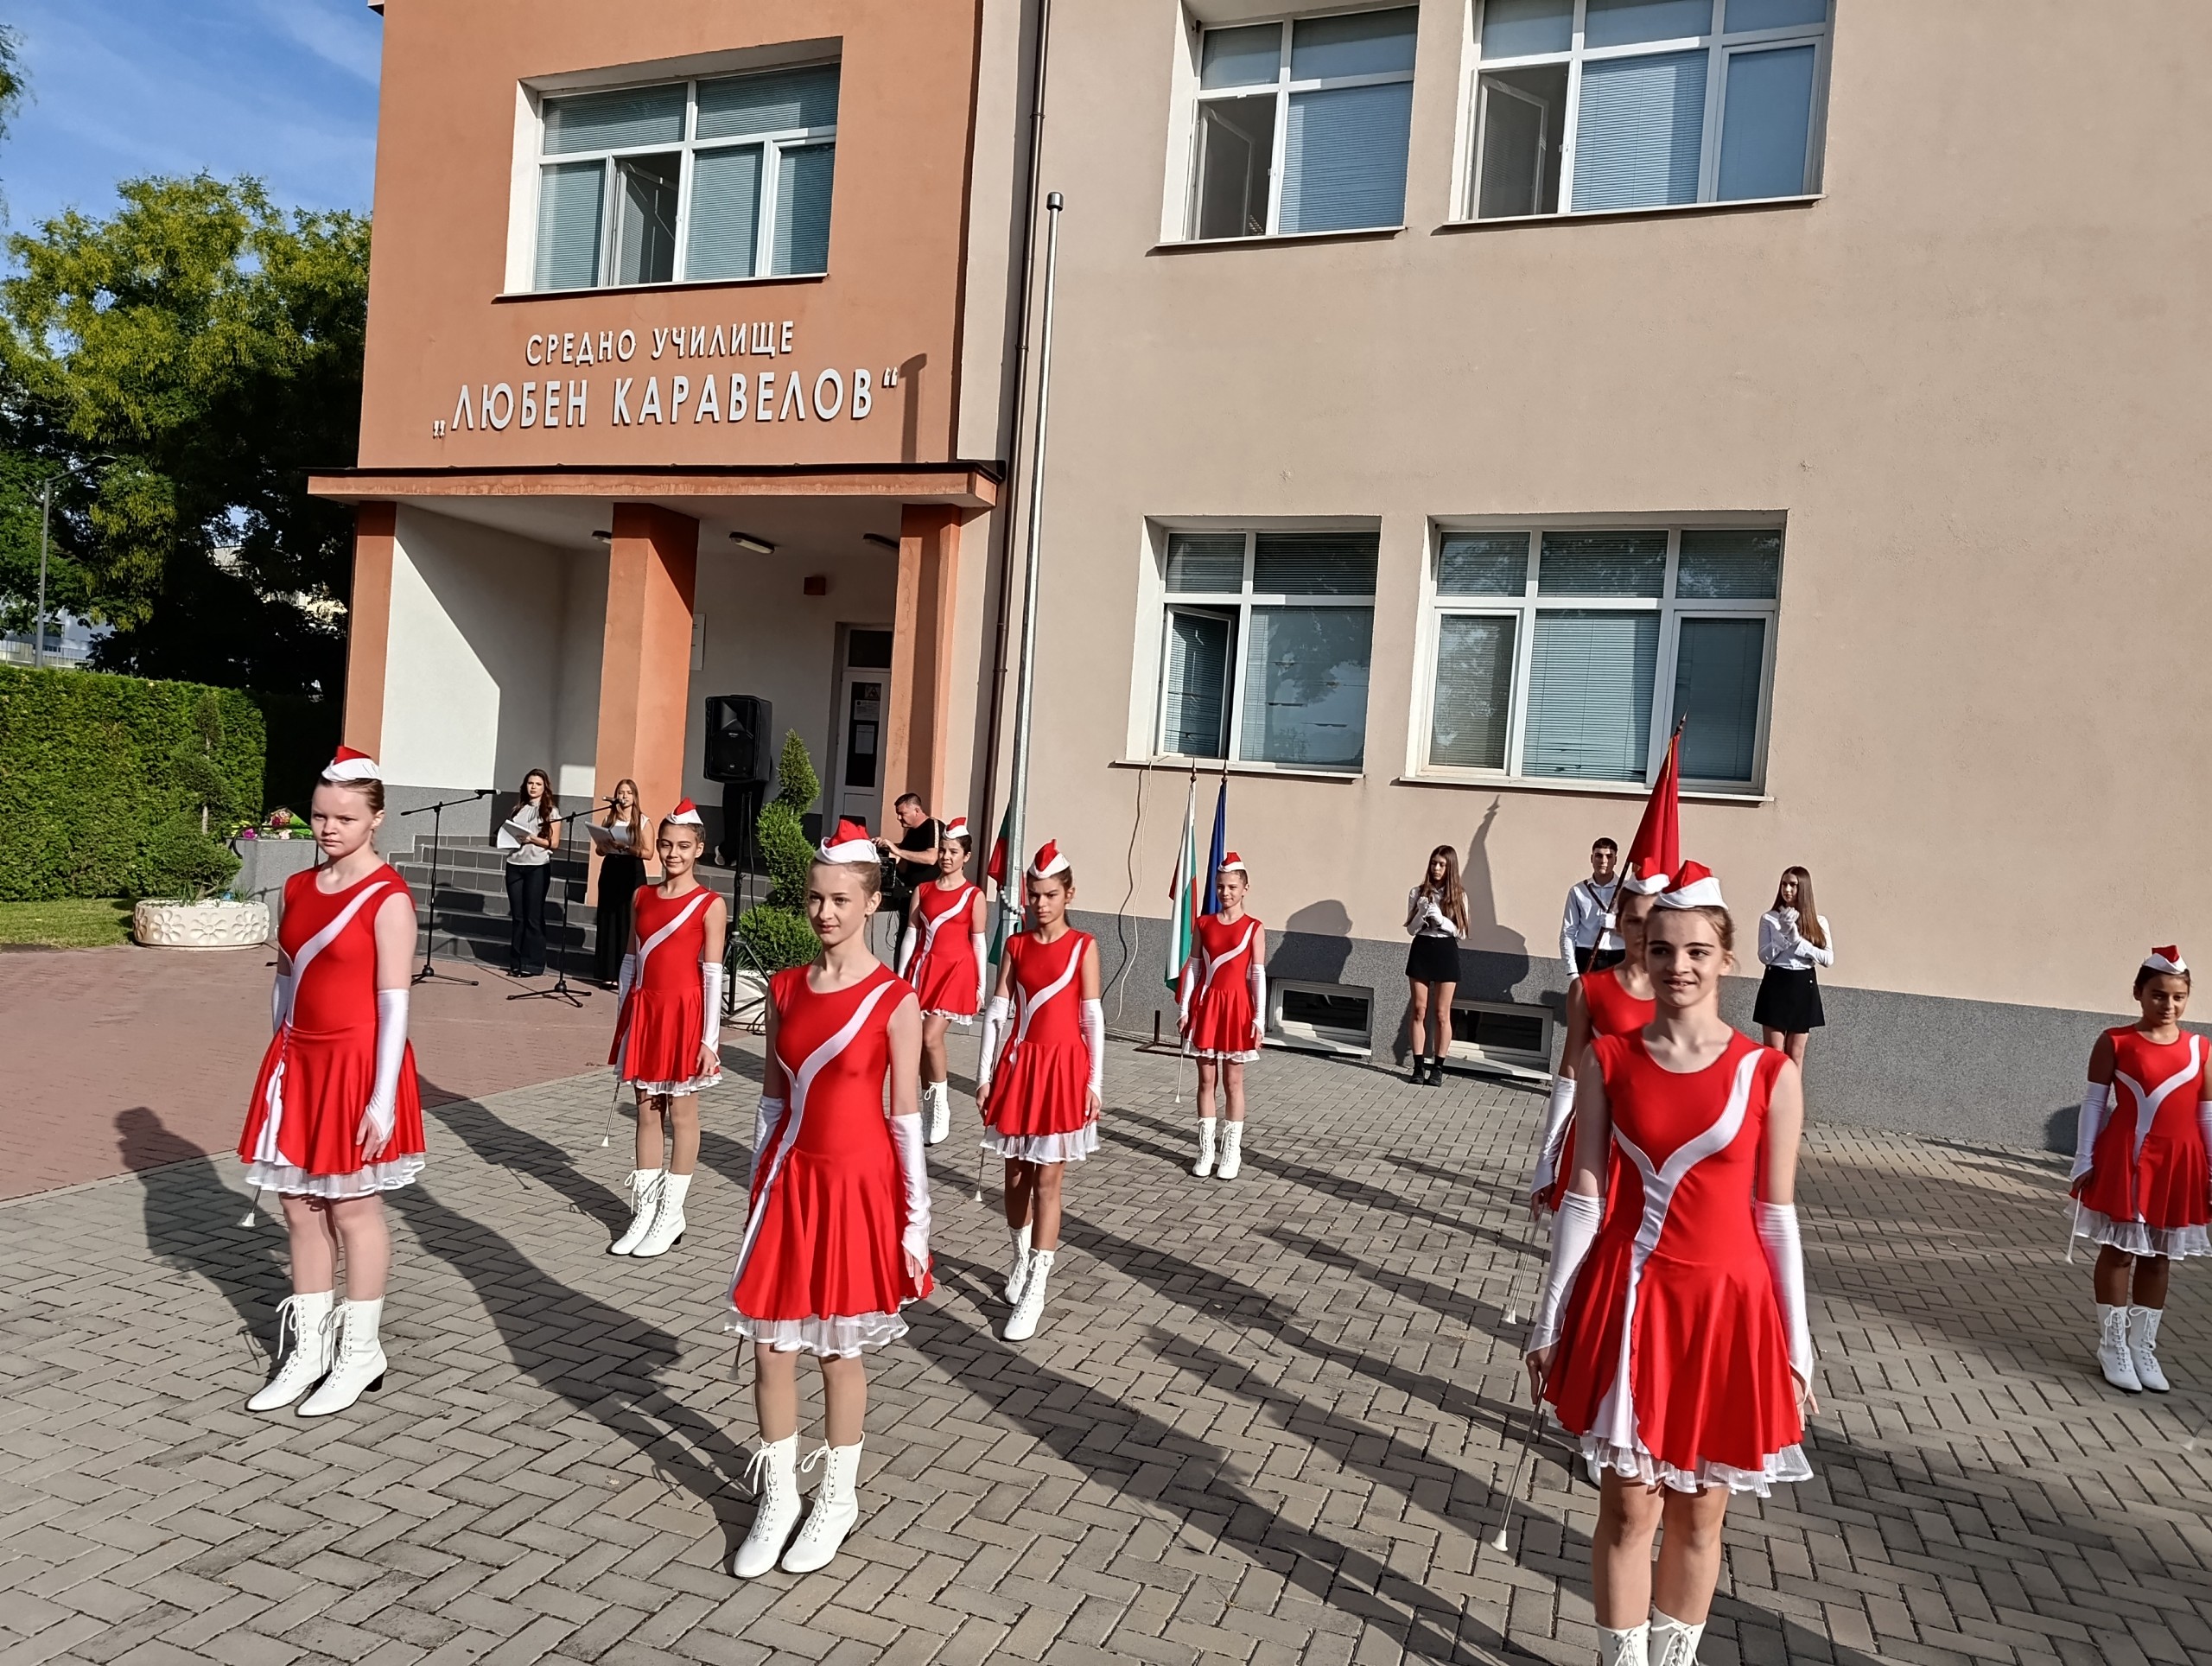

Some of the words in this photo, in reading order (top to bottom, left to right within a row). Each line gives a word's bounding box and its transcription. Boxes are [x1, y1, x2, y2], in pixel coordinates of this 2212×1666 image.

[525, 328, 636, 366] СРЕДНО
[651, 321, 794, 359] УЧИЛИЩЕ
[433, 379, 588, 437] „ЛЮБЕН
[612, 366, 898, 424] КАРАВЕЛОВ“
